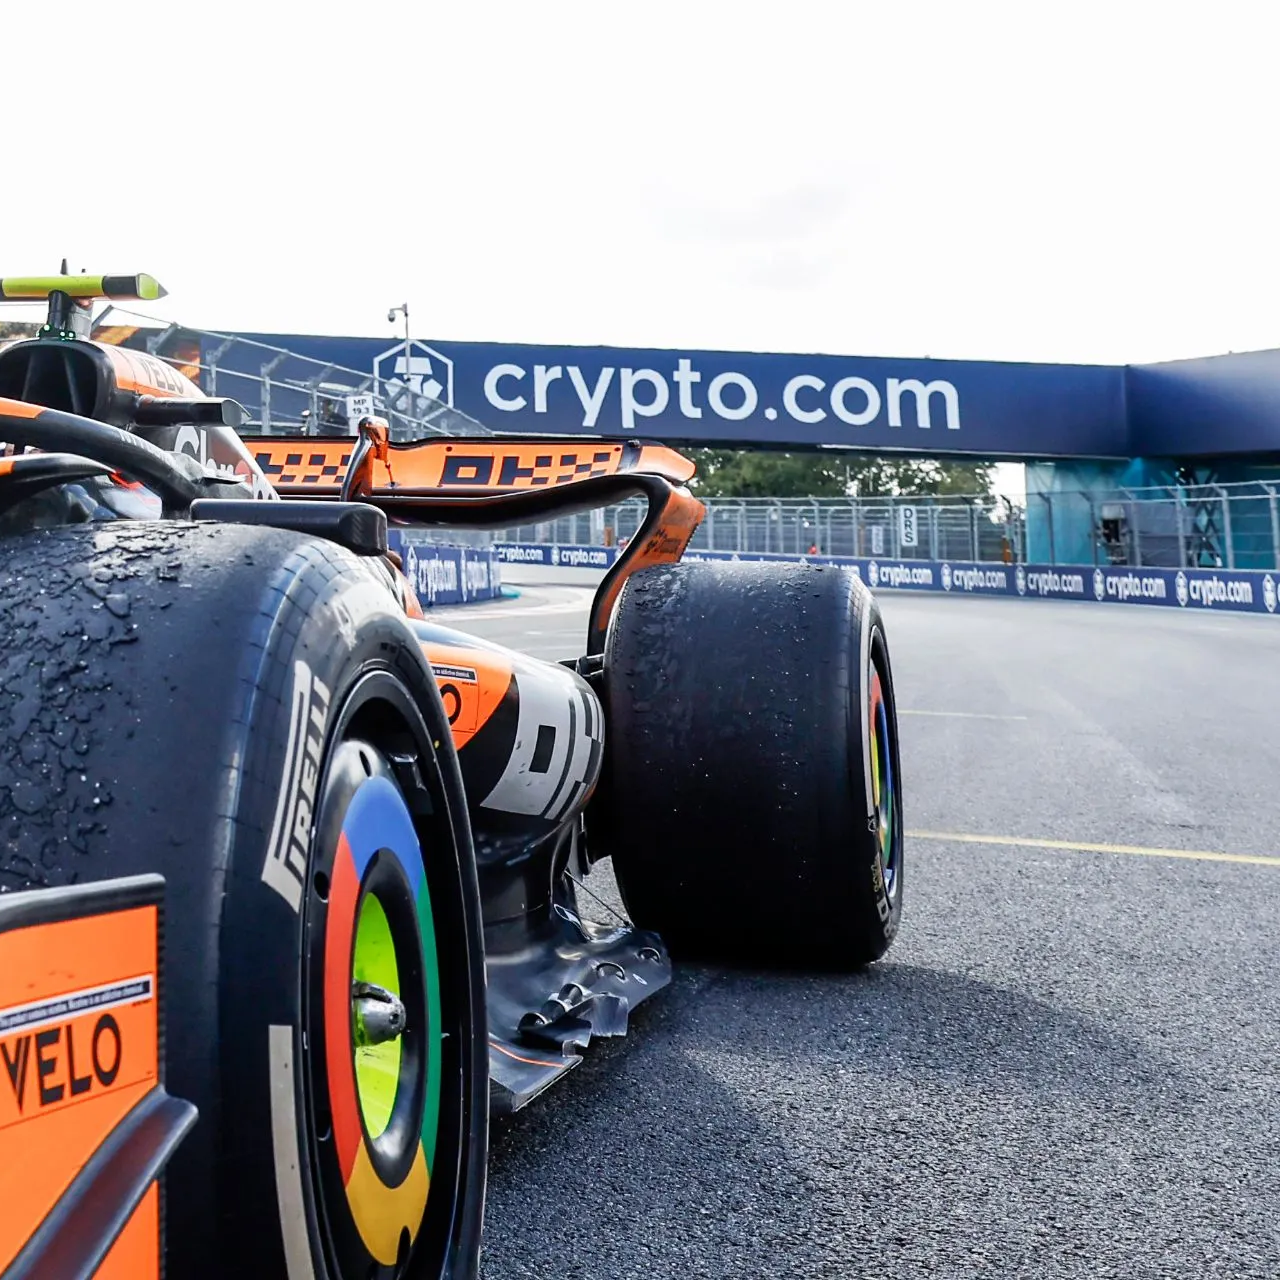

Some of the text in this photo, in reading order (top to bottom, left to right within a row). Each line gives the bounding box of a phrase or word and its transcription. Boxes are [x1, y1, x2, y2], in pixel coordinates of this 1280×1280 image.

[140, 356, 184, 394] VELO
[484, 358, 961, 430] crypto.com
[442, 452, 611, 485] OKX
[903, 508, 914, 543] DRS
[561, 546, 607, 567] crypto.com
[880, 562, 933, 586] crypto.com
[953, 567, 1007, 591] crypto.com
[1028, 570, 1083, 594] crypto.com
[1106, 572, 1167, 600] crypto.com
[1190, 576, 1253, 606] crypto.com
[262, 660, 331, 914] PIRELLI
[0, 1013, 122, 1116] VELO
